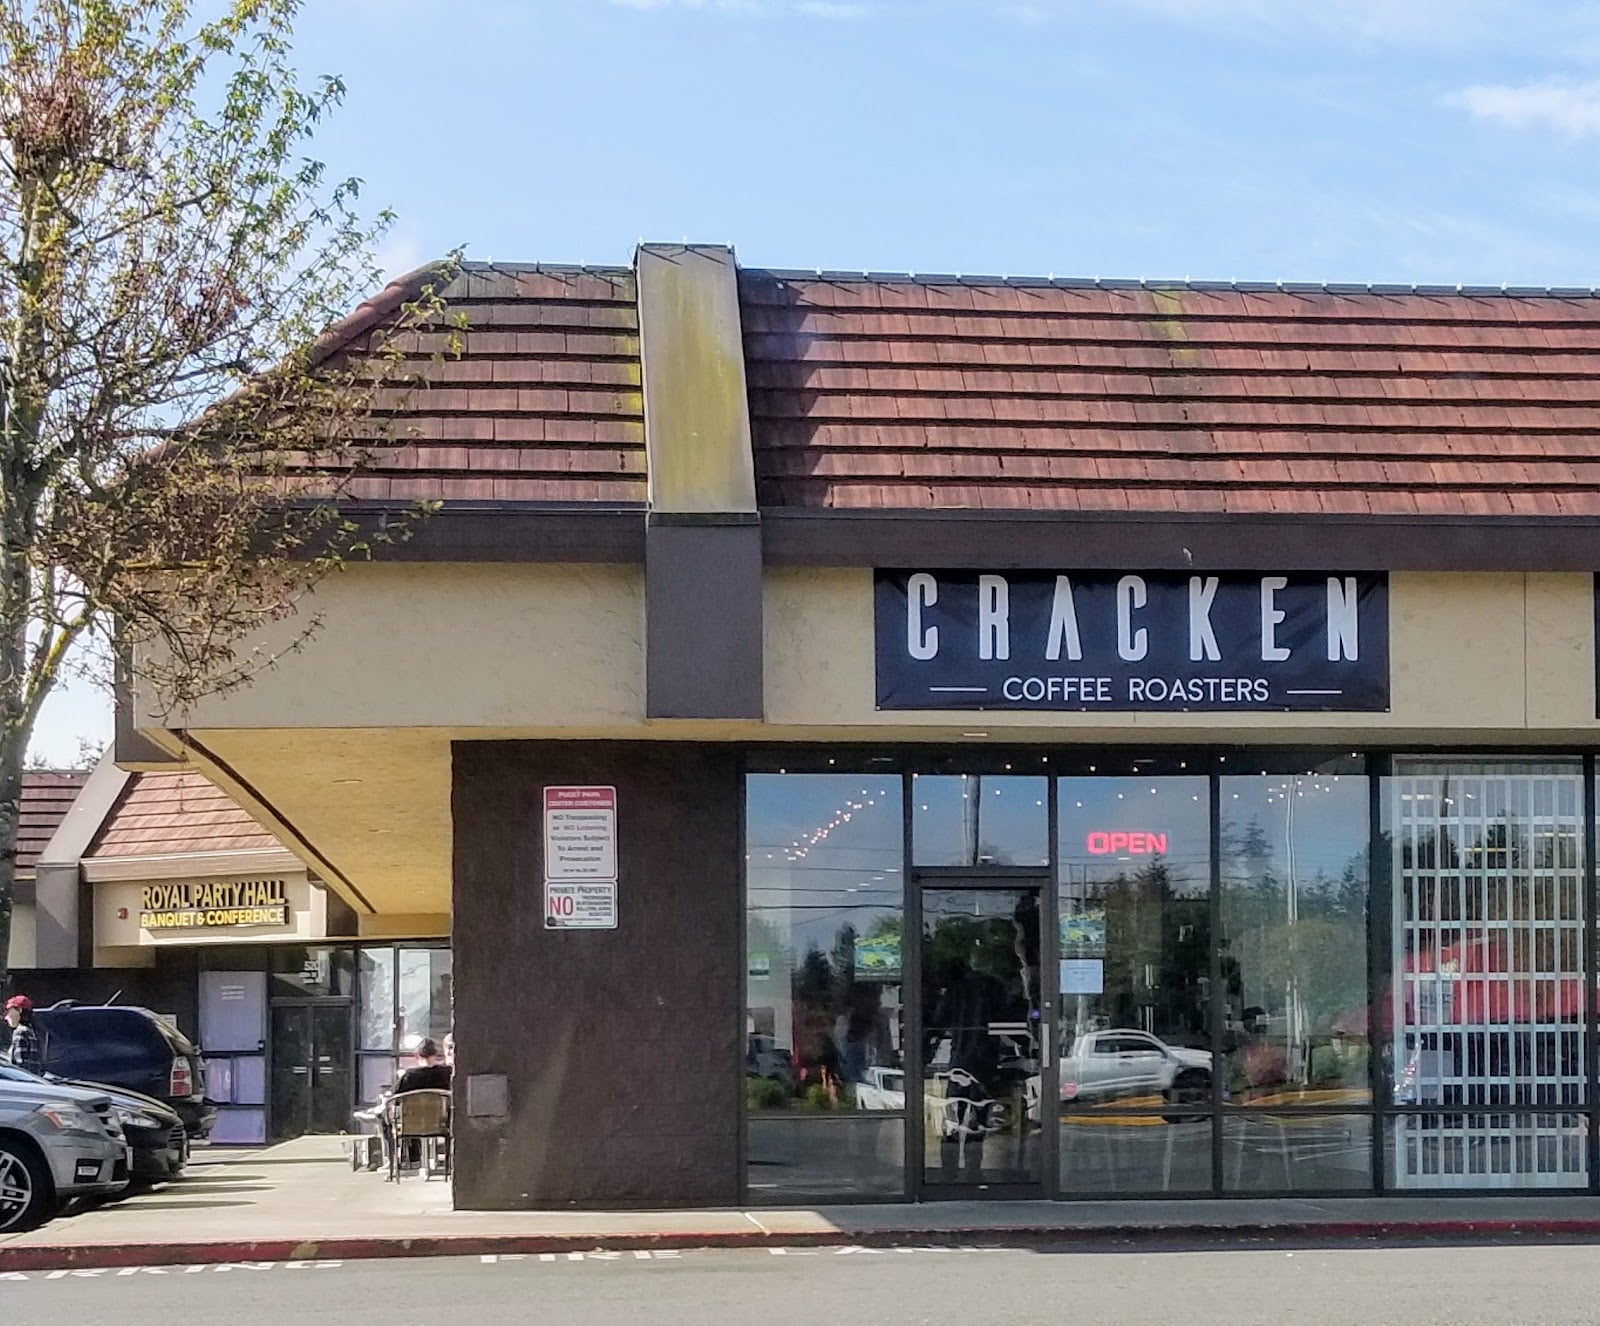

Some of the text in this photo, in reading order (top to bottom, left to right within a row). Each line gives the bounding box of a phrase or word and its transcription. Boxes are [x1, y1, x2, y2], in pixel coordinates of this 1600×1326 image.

[907, 572, 1358, 661] CRACKEN
[1002, 677, 1269, 701] COFFEE ROASTERS
[1086, 831, 1168, 855] OPEN
[142, 880, 286, 909] ROYAL PARTY HALL
[549, 896, 574, 916] NO
[140, 908, 285, 927] BANQUET & CONFERENCE
